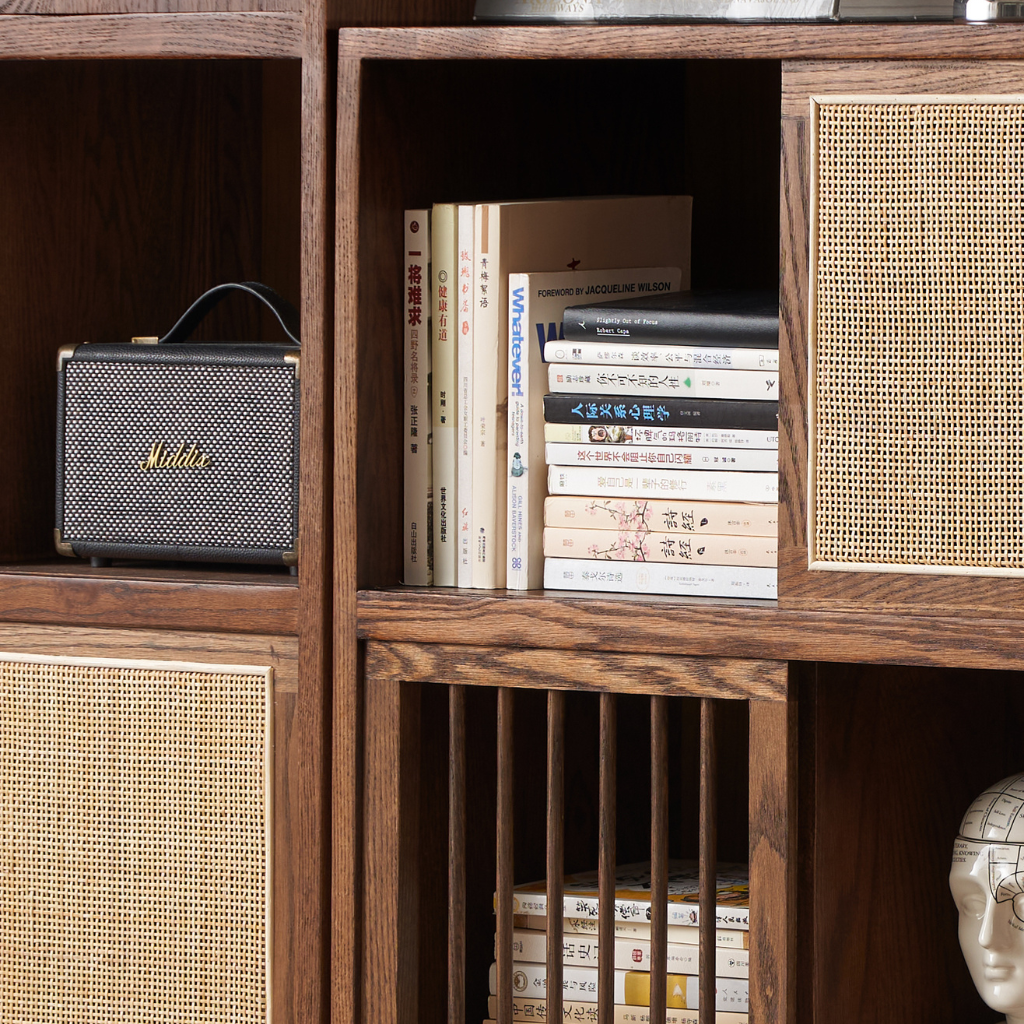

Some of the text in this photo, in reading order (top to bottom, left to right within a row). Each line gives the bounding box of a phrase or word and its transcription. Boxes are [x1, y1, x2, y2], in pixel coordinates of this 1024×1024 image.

[538, 282, 671, 298] FOREWORD BY JACQUELINE WILSON
[438, 285, 447, 341] 健康有道
[596, 317, 621, 326] Slightly
[616, 327, 630, 335] Capa
[511, 287, 525, 397] Whatever!
[571, 403, 670, 421] 人际关系心理学
